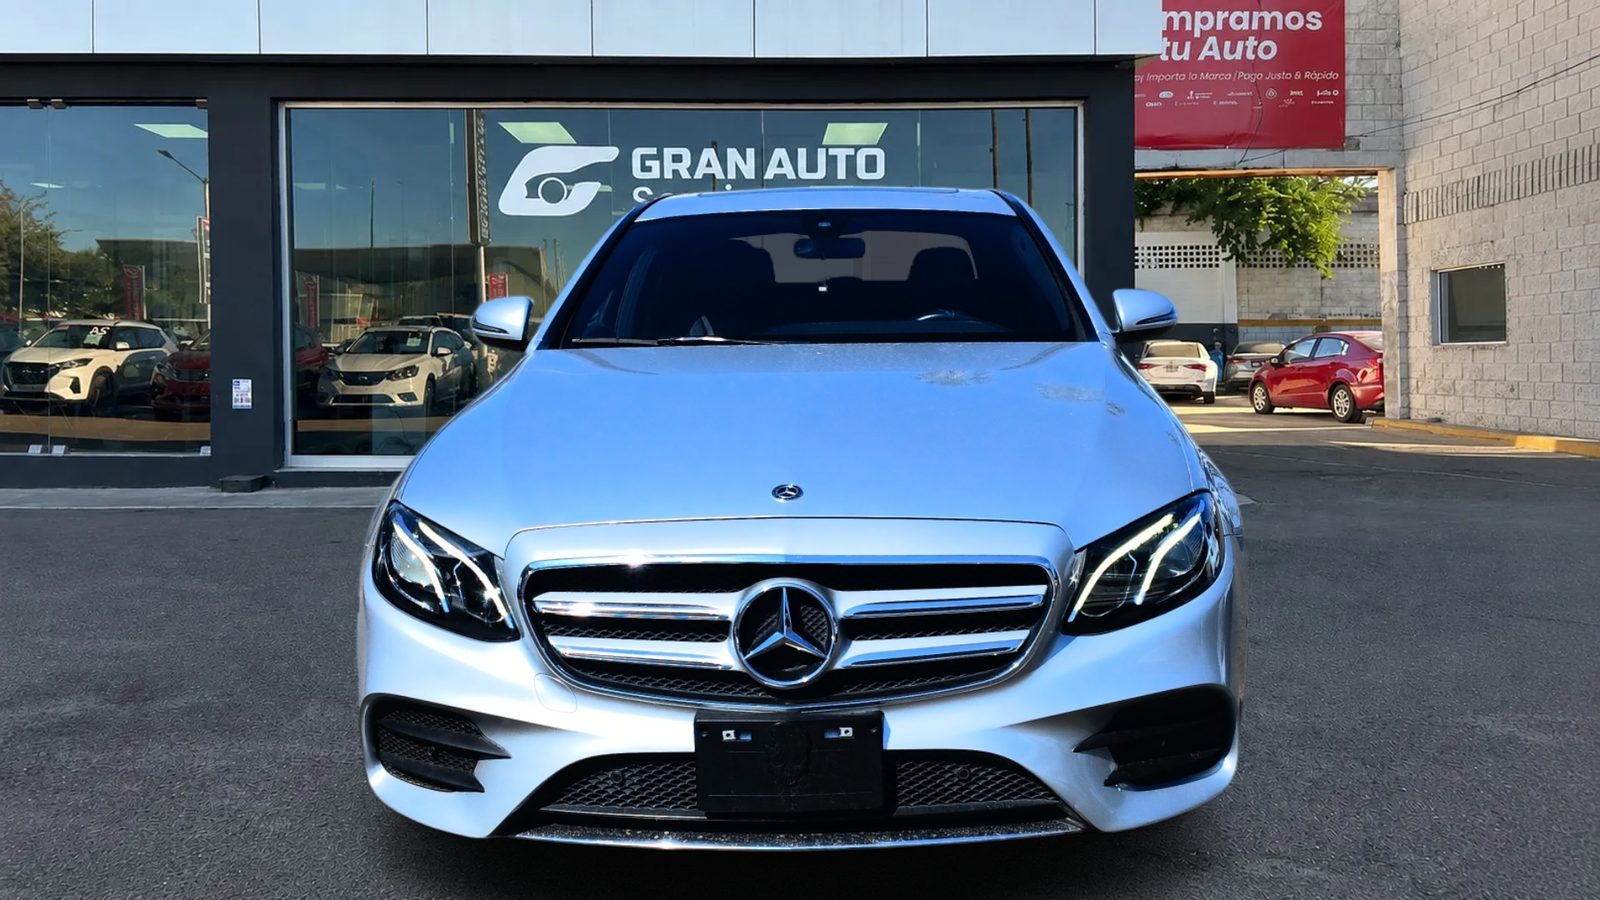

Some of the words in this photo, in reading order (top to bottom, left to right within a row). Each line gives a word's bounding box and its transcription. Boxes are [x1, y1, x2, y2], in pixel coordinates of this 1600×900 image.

[1160, 37, 1191, 61] tu
[1197, 35, 1278, 61] Auto
[1146, 72, 1186, 83] Importa
[1188, 72, 1198, 81] la
[1199, 72, 1232, 81] Marca
[1294, 71, 1302, 80] &
[1303, 70, 1339, 82] Rápido
[632, 147, 756, 180] GRAN
[763, 147, 886, 180] AUTO
